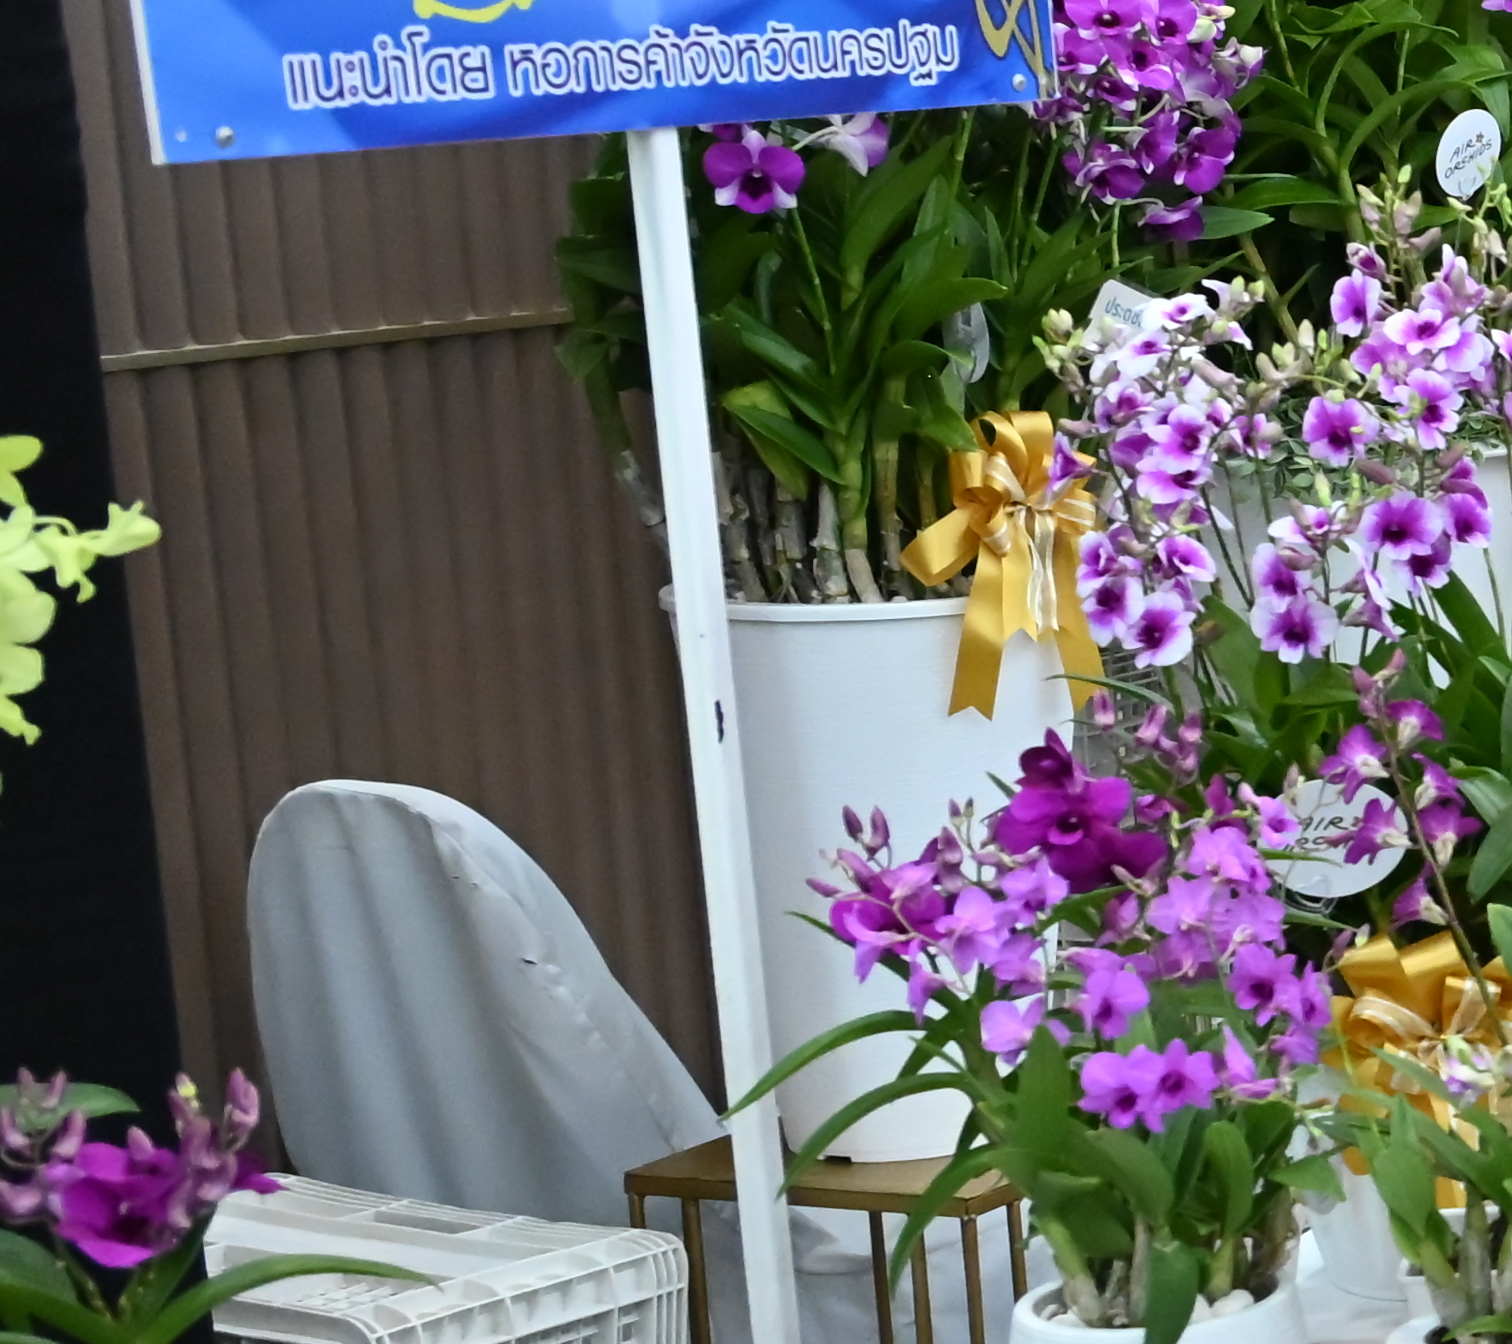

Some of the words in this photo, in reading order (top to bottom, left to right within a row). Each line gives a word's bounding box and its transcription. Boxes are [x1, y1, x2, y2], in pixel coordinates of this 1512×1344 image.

[286, 27, 492, 105] แนะนำโดย
[511, 21, 958, 94] หอการค้าจังหวัดนครปฐม
[1449, 138, 1476, 163] AIR
